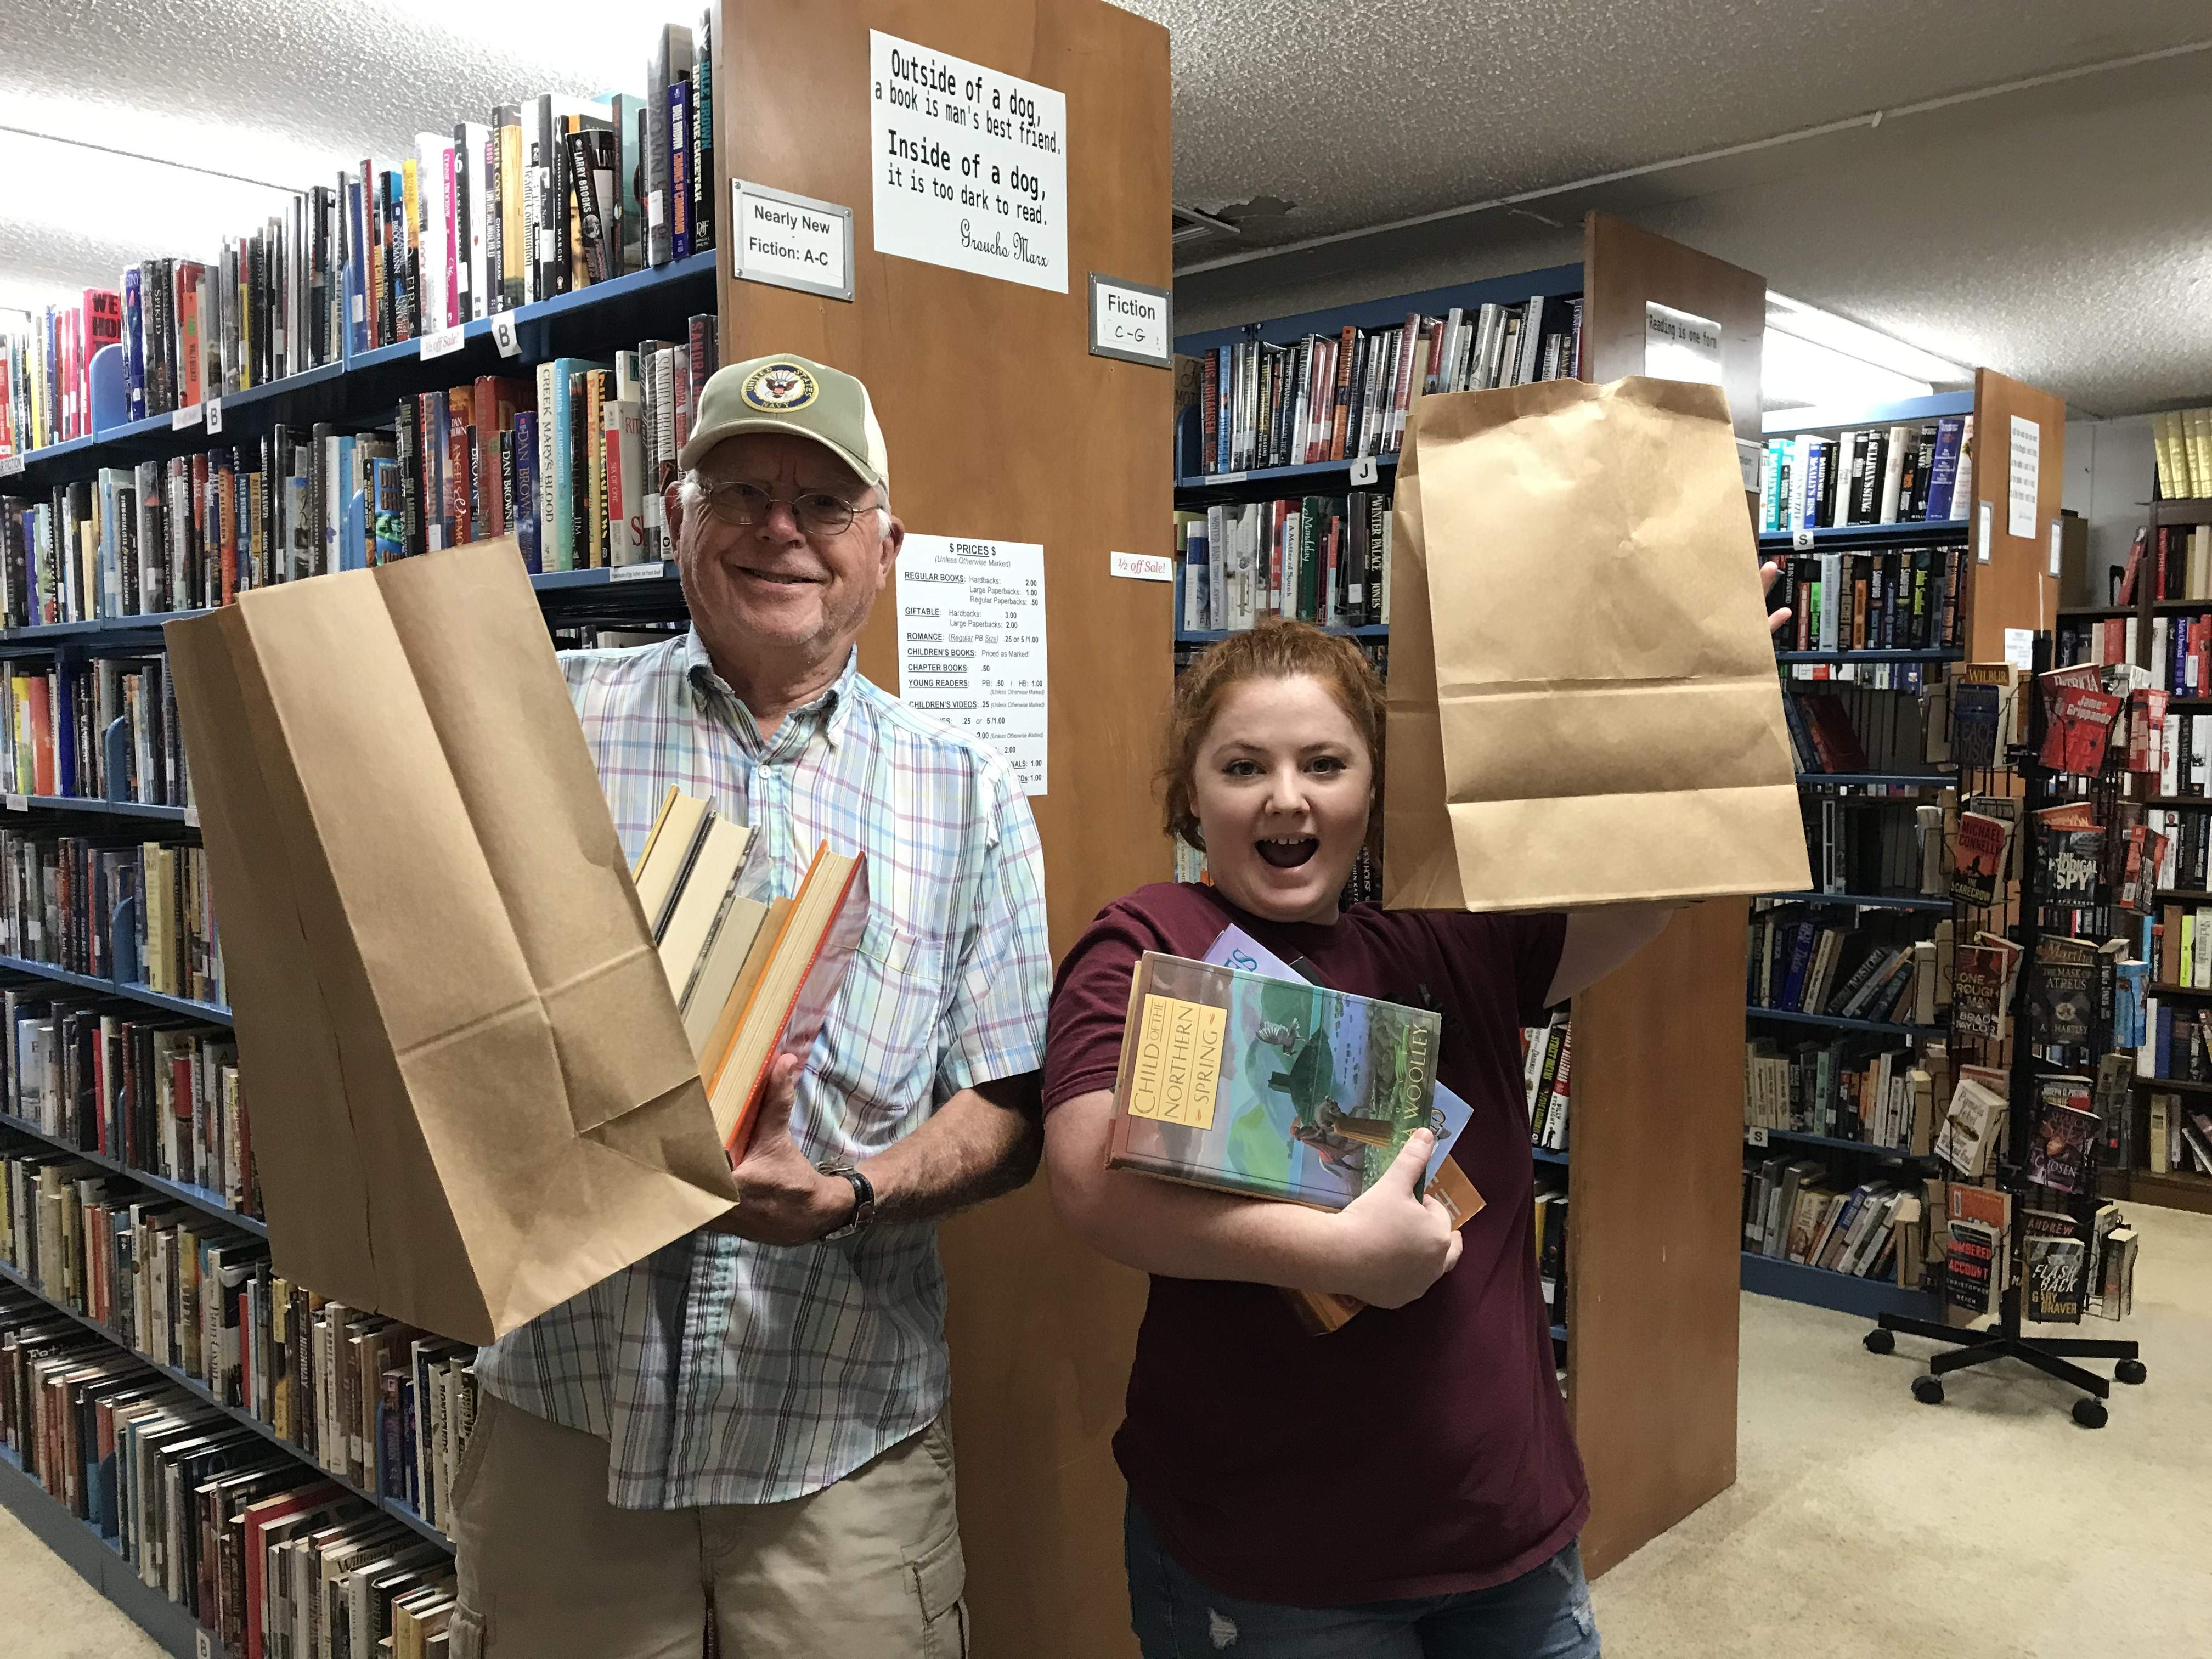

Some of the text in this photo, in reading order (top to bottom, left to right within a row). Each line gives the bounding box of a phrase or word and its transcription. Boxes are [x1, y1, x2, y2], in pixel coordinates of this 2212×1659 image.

[891, 49, 1041, 127] Outside of a dog,
[693, 92, 701, 108] OF
[701, 60, 712, 150] DALE BROWN
[875, 80, 1060, 154] a book is man's best friend.
[693, 140, 702, 202] CHEETAH
[888, 129, 1046, 201] Inside of a dog,
[574, 151, 591, 213] LARRY BROOKS
[888, 162, 1047, 225] it is too dark to read.
[754, 205, 830, 234] Nearly New
[391, 220, 400, 274] BROCKMANN
[749, 236, 828, 266] Fiction: A-C
[960, 218, 1048, 267] Groucho Marx
[92, 293, 118, 314] WE
[1108, 294, 1155, 320] Fiction
[433, 336, 442, 349] off
[443, 331, 459, 346] Sale!
[498, 323, 510, 347] B
[1649, 314, 1717, 348] Reading is one form
[747, 366, 813, 397] UNITED STATES
[657, 356, 673, 458] SANDRA BROWN
[211, 408, 218, 426] B
[543, 369, 554, 523] CREEK MARY'S BLOOD
[471, 447, 479, 499] BROWN
[518, 430, 531, 522] DAN BROWN
[1360, 464, 1369, 478] J
[502, 450, 512, 520] DAN BROWN
[1799, 534, 1808, 545] S
[949, 543, 996, 557] $ PRICES $
[1371, 496, 1383, 608] WINTER PALACE JONES
[935, 555, 1011, 568] (Unless Otherwise Marked)
[1131, 560, 1144, 574] off
[1145, 561, 1165, 573] Sale!
[905, 572, 938, 581] REGULAR
[940, 574, 966, 583] BOOKS:
[969, 576, 1001, 584] Hardbacks:
[969, 586, 986, 595] Large
[987, 587, 1022, 595] Paperbacks:
[970, 596, 992, 605] Regular
[993, 597, 1027, 606] Paperbacks:
[905, 607, 942, 617] GIFTABLE:
[949, 609, 981, 617] Hardbacks:
[950, 619, 967, 628] Large
[968, 620, 1003, 629] Paperbacks:
[907, 632, 945, 641] ROMANCE:
[948, 634, 974, 642] (Regular
[985, 635, 998, 643] Size)
[907, 648, 949, 657] CHILDREN'S
[951, 649, 977, 657] BOOKS:
[908, 664, 941, 672] CHAPTER
[943, 664, 969, 673] BOOKS:
[1968, 668, 2007, 684] WILBUR
[909, 701, 951, 709] CHILDREN'S
[2078, 695, 2107, 710] James
[1961, 820, 2002, 842] MICHAEL
[1959, 834, 2002, 855] CONNELLY
[2048, 857, 2097, 873] PRODIGAL
[2053, 871, 2090, 890] SPY
[1951, 882, 1991, 901] SCARECROW
[1960, 972, 1985, 985] ONE
[2046, 978, 2087, 990] ATREUS
[1956, 983, 1999, 998] ROUGH
[1956, 1020, 1995, 1033] TAYLOR
[1960, 1012, 1990, 1024] BRAD
[2055, 1024, 2088, 1035] HARTLEY
[1134, 1001, 1164, 1114] CHILD OF THE
[1164, 1005, 1194, 1119] NORTHERN
[1194, 1029, 1218, 1104] SPRING
[1403, 1023, 1428, 1119] WOOLLEY
[1753, 1130, 1763, 1142] S
[2028, 1218, 2074, 1235] ANDREW
[1949, 1259, 1988, 1280] ACCOUNT
[2032, 1264, 2080, 1281] FLASH
[2041, 1276, 2078, 1293] BACK
[2041, 1302, 2077, 1314] BRAVER
[300, 1335, 308, 1388] HIGHWAY
